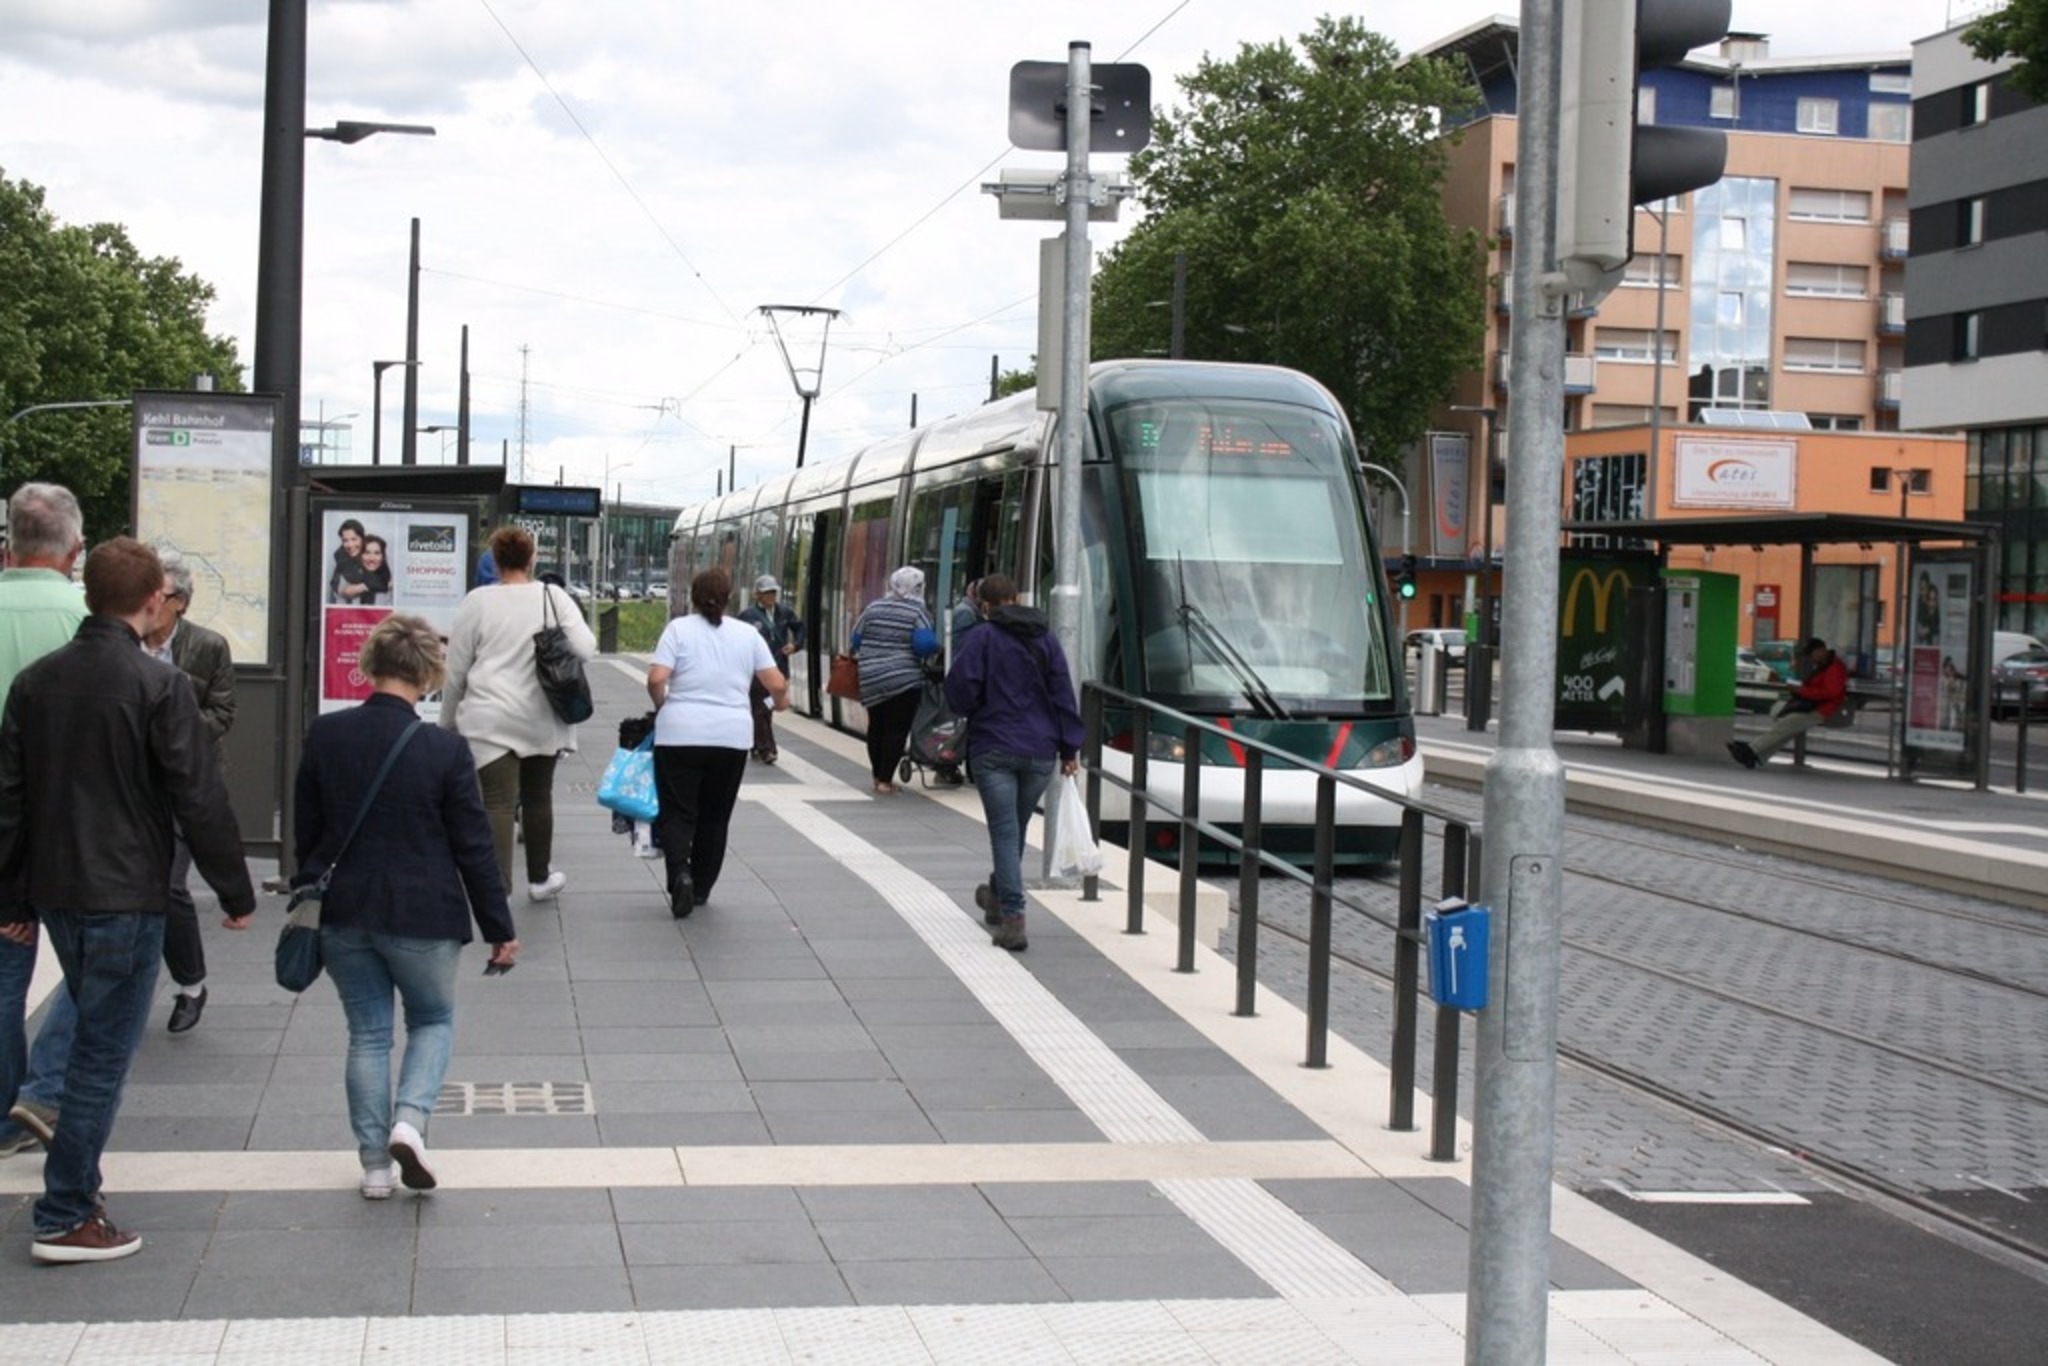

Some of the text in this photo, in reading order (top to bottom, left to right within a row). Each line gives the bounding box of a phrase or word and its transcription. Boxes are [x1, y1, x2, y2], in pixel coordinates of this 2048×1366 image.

[143, 412, 225, 427] Kehl Bahnhof
[173, 431, 187, 445] D
[409, 538, 453, 551] rivetoile
[406, 566, 457, 575] SHOPPING
[1563, 675, 1594, 690] 400
[1560, 690, 1595, 701] METER
